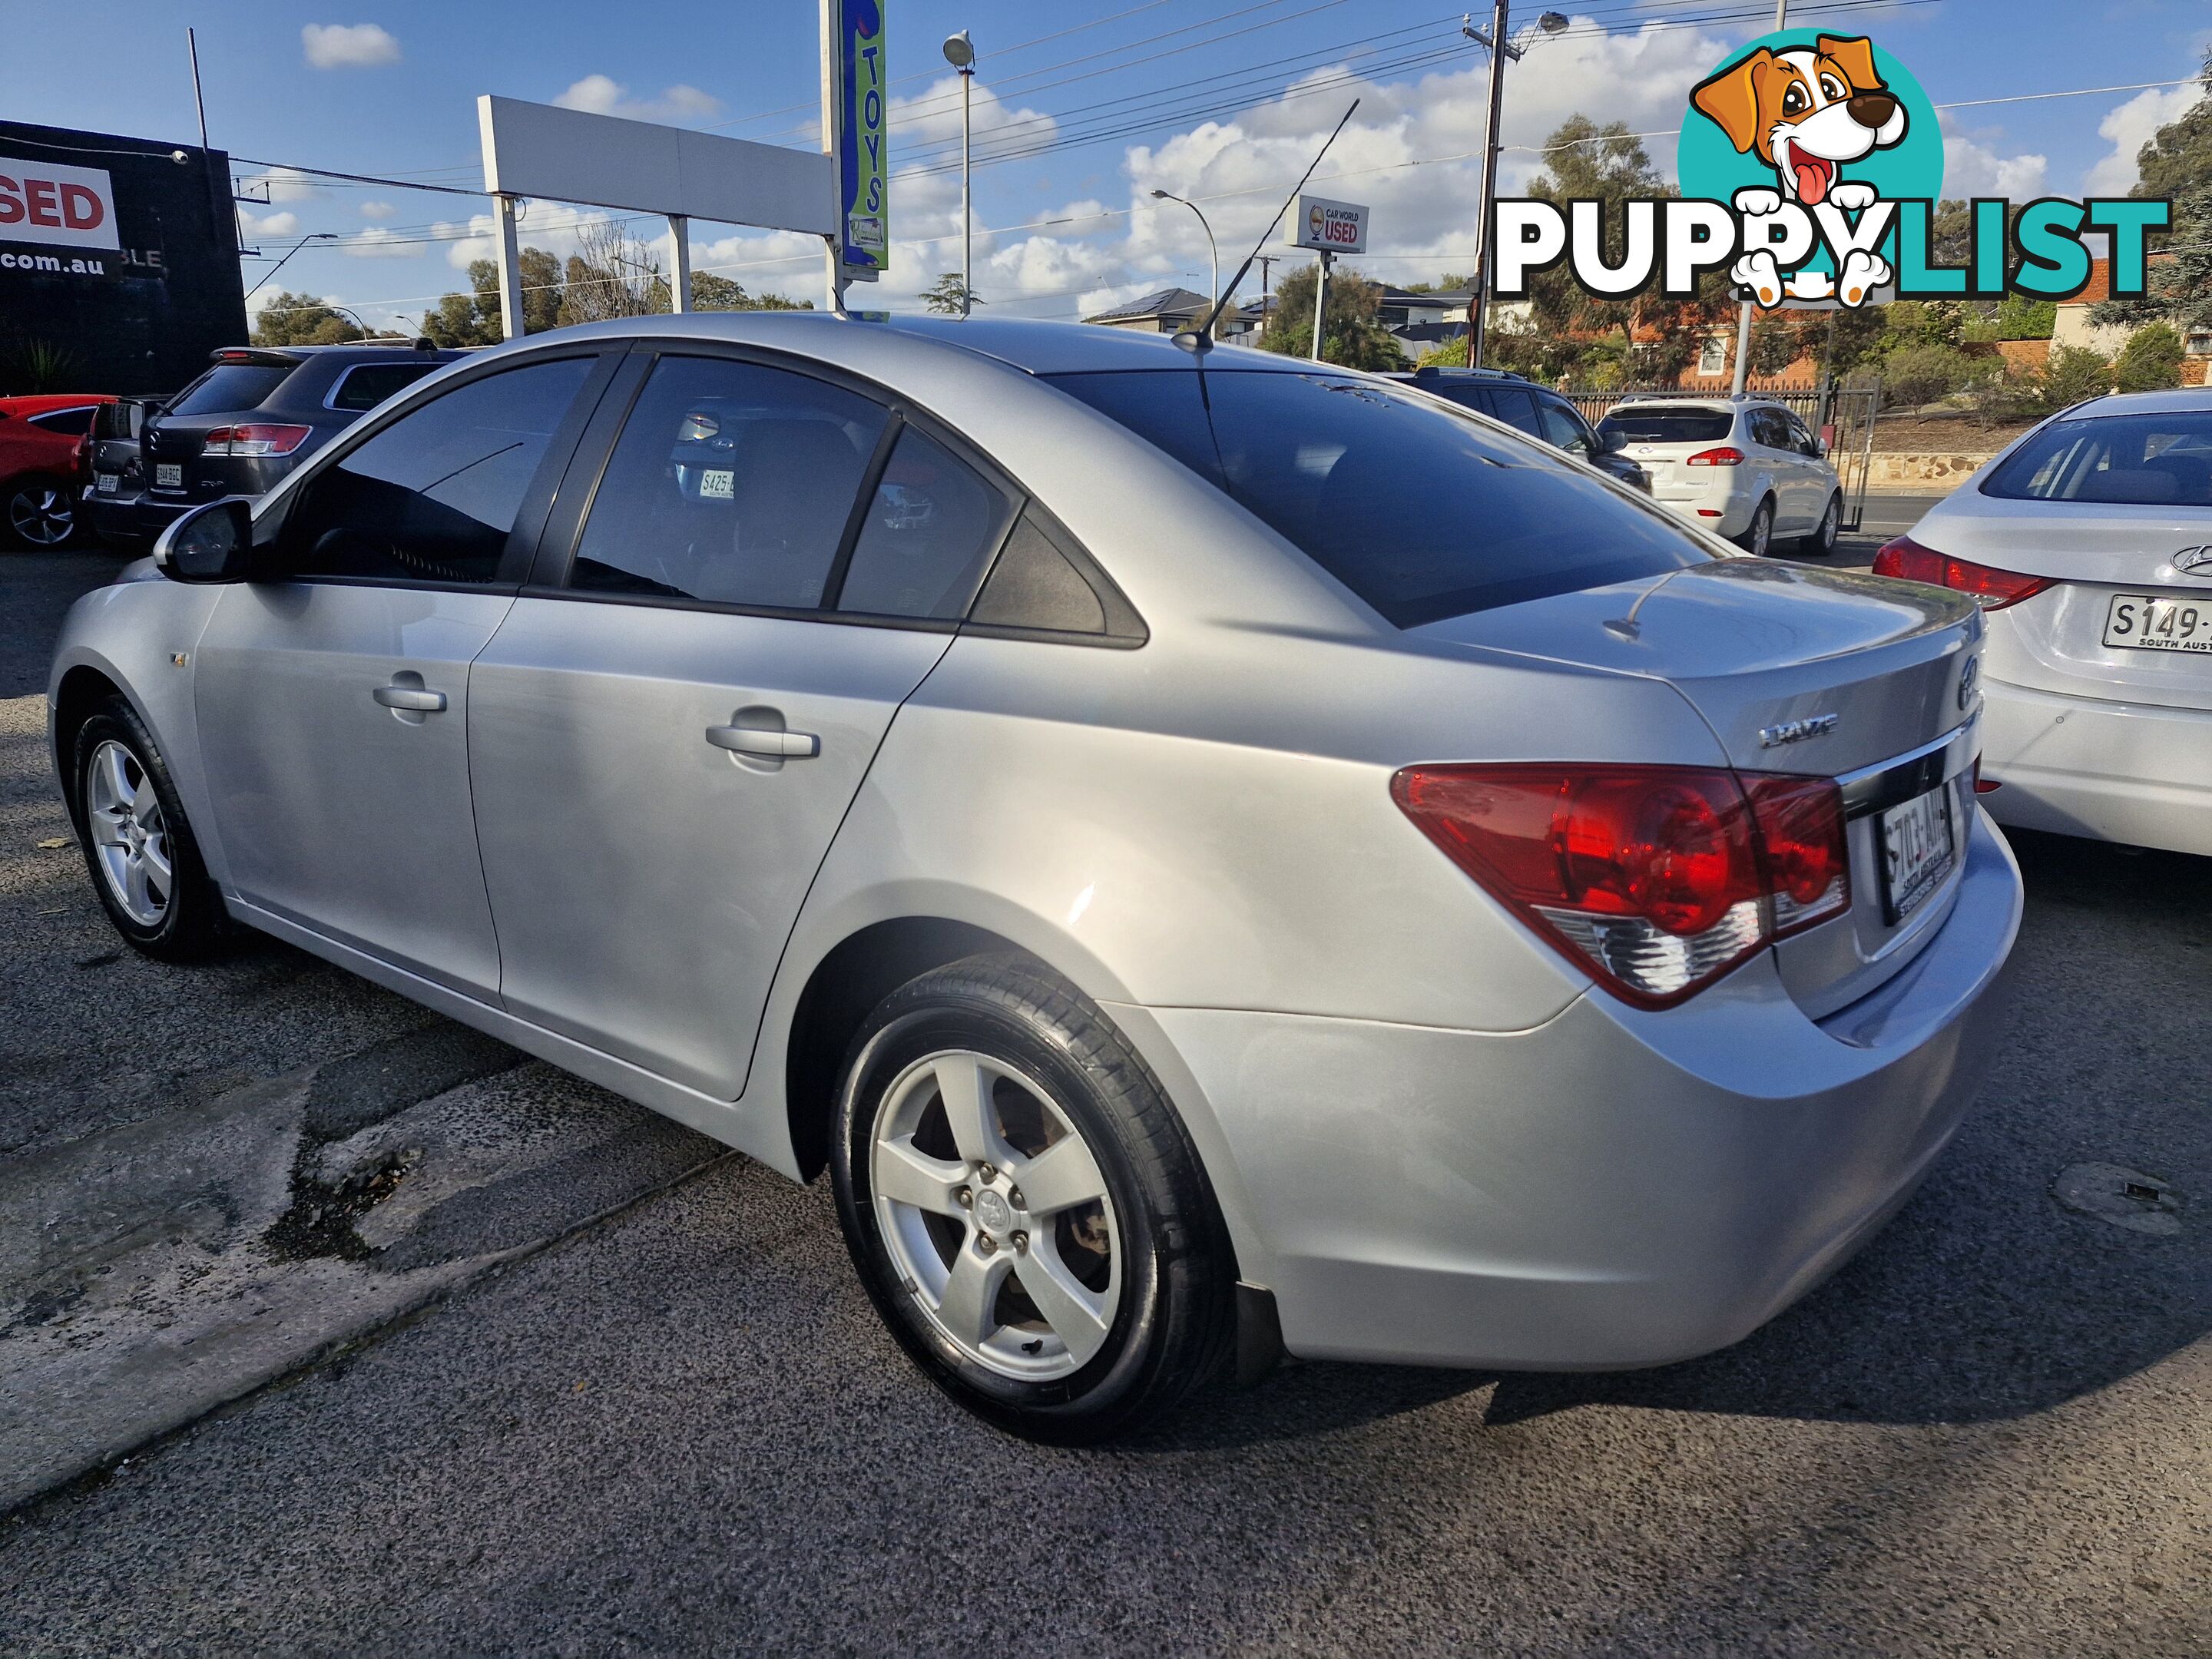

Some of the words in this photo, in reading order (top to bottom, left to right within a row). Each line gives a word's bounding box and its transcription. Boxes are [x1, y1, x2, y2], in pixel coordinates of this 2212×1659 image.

[862, 46, 882, 213] TOYS
[1326, 209, 1339, 219] CAR
[1339, 211, 1359, 222] WORLD
[1325, 219, 1358, 243] USED
[2112, 604, 2212, 638] S149-
[2139, 638, 2179, 647] SOUTH
